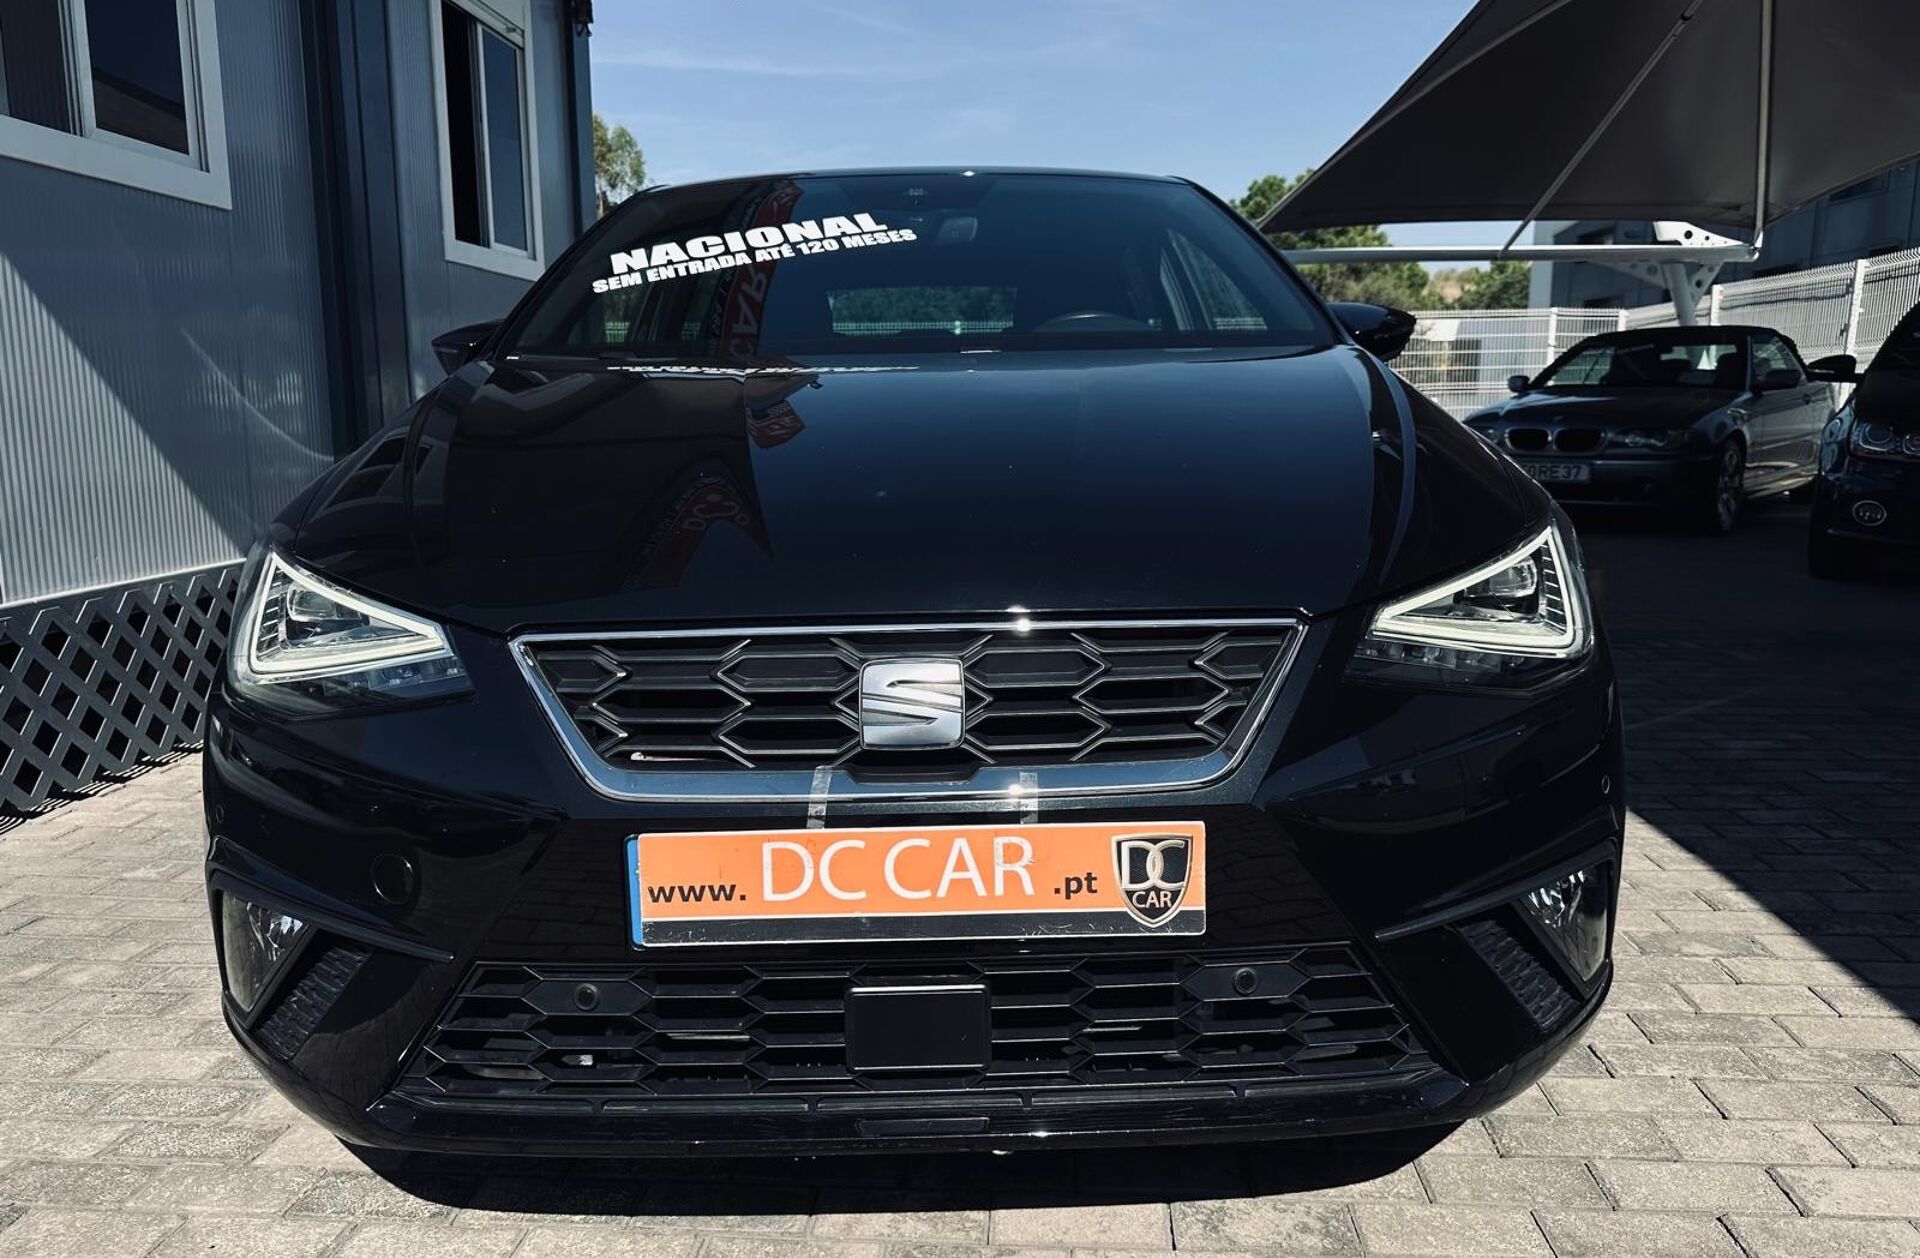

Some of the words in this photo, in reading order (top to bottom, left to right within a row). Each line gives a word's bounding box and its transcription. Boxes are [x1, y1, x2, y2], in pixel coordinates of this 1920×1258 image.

[592, 271, 643, 293] SEM
[646, 252, 752, 282] ENTRADA
[755, 243, 796, 263] ATÉ
[796, 238, 840, 255] 120
[841, 229, 917, 249] MESES
[610, 212, 888, 275] NACIONAL
[647, 884, 747, 903] www.
[762, 839, 866, 902] DC
[884, 836, 1036, 900] CAR
[1053, 872, 1098, 900] .pt
[1121, 839, 1186, 891] DC
[1132, 890, 1173, 909] CAR
